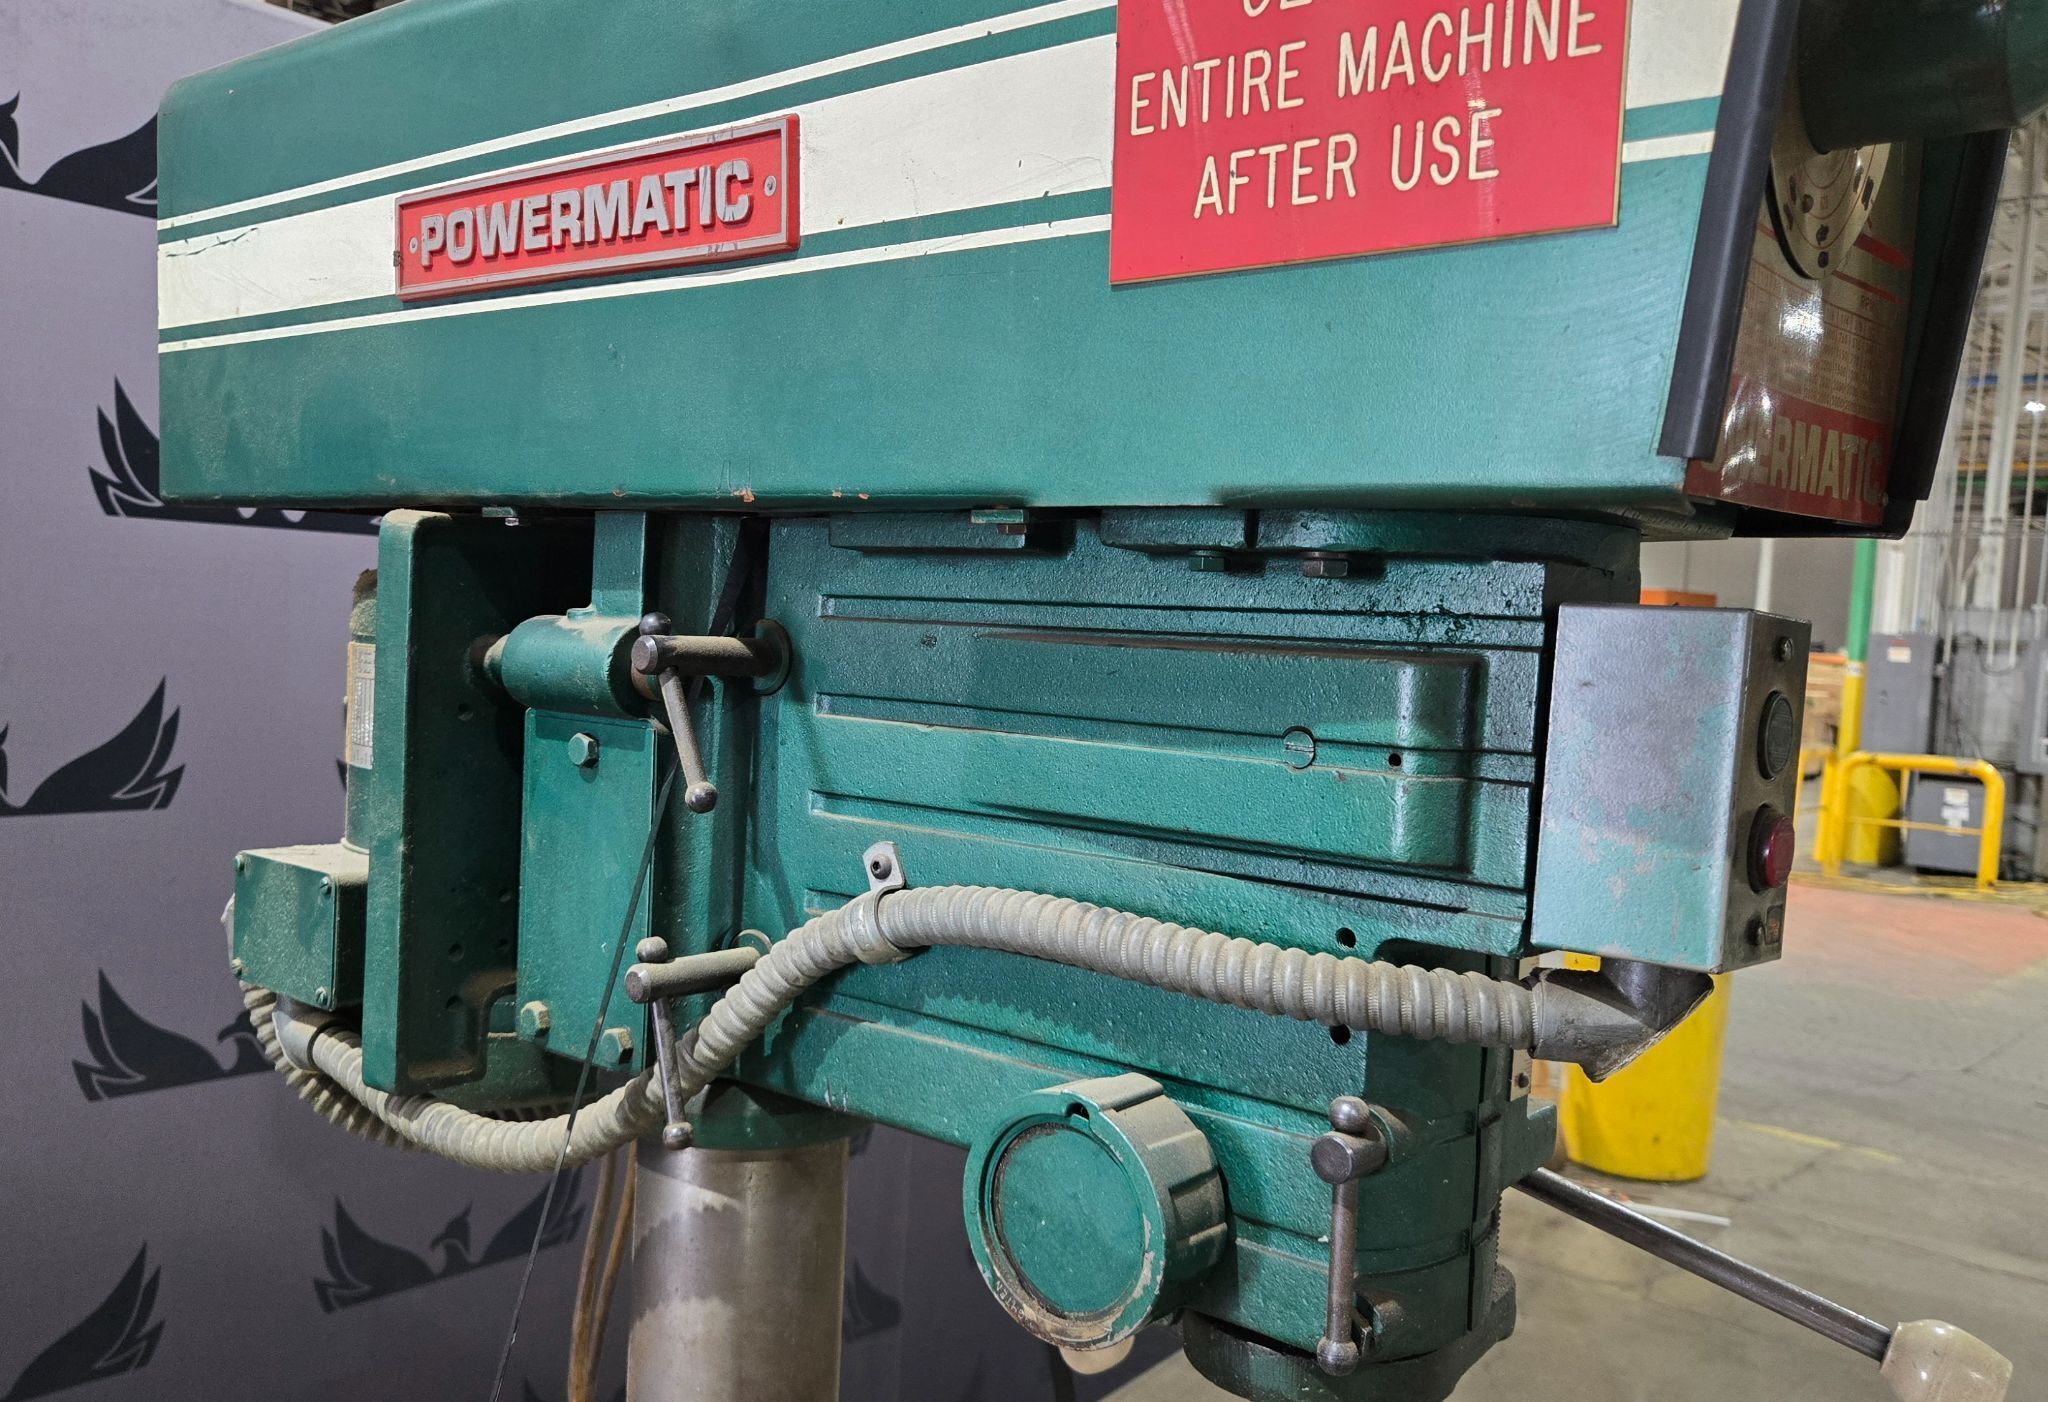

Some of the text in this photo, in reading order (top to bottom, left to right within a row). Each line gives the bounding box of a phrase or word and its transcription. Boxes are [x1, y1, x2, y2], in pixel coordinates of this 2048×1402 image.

[1130, 0, 1603, 136] ENTIRE MACHINE
[420, 158, 753, 268] POWERMATIC
[1193, 108, 1503, 219] AFTER USE
